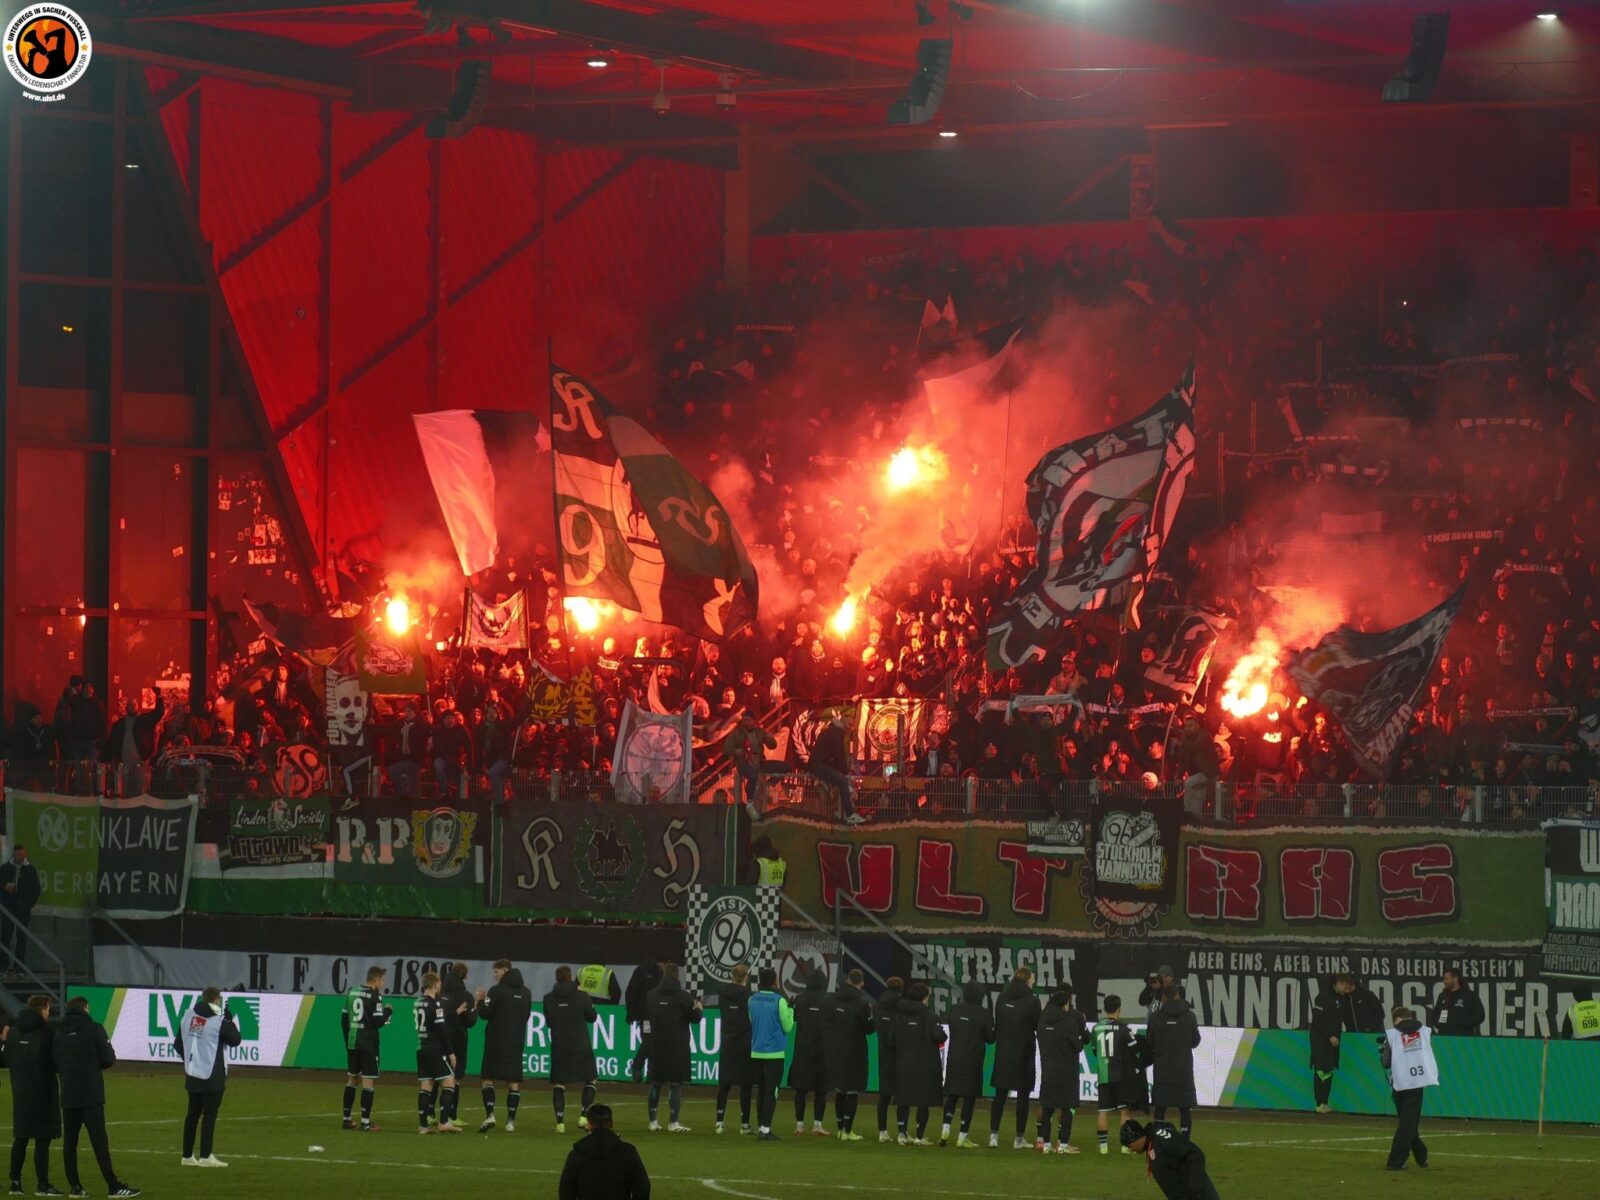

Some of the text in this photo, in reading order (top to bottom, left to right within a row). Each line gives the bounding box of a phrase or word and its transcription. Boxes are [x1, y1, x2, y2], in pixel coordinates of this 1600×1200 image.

[233, 804, 325, 830] Linden Society
[74, 815, 182, 851] ENKLAVE
[1096, 842, 1163, 864] STOCKHOLM
[40, 870, 178, 897] BERBAYERN
[1096, 860, 1161, 882] HANNOVER
[716, 899, 747, 913] HSV
[714, 917, 747, 963] 96
[700, 944, 733, 979] Hanno
[910, 944, 1075, 988] EINTRACHT
[1188, 951, 1224, 970] ABER
[1230, 952, 1267, 973] EINS,
[1273, 954, 1311, 973] ABER
[1361, 957, 1390, 976] DAS
[1396, 958, 1445, 977] BLEIBT
[352, 998, 365, 1022] 9
[1582, 1018, 1599, 1029] 698
[1096, 1031, 1115, 1058] 11
[1409, 1065, 1425, 1077] 03
